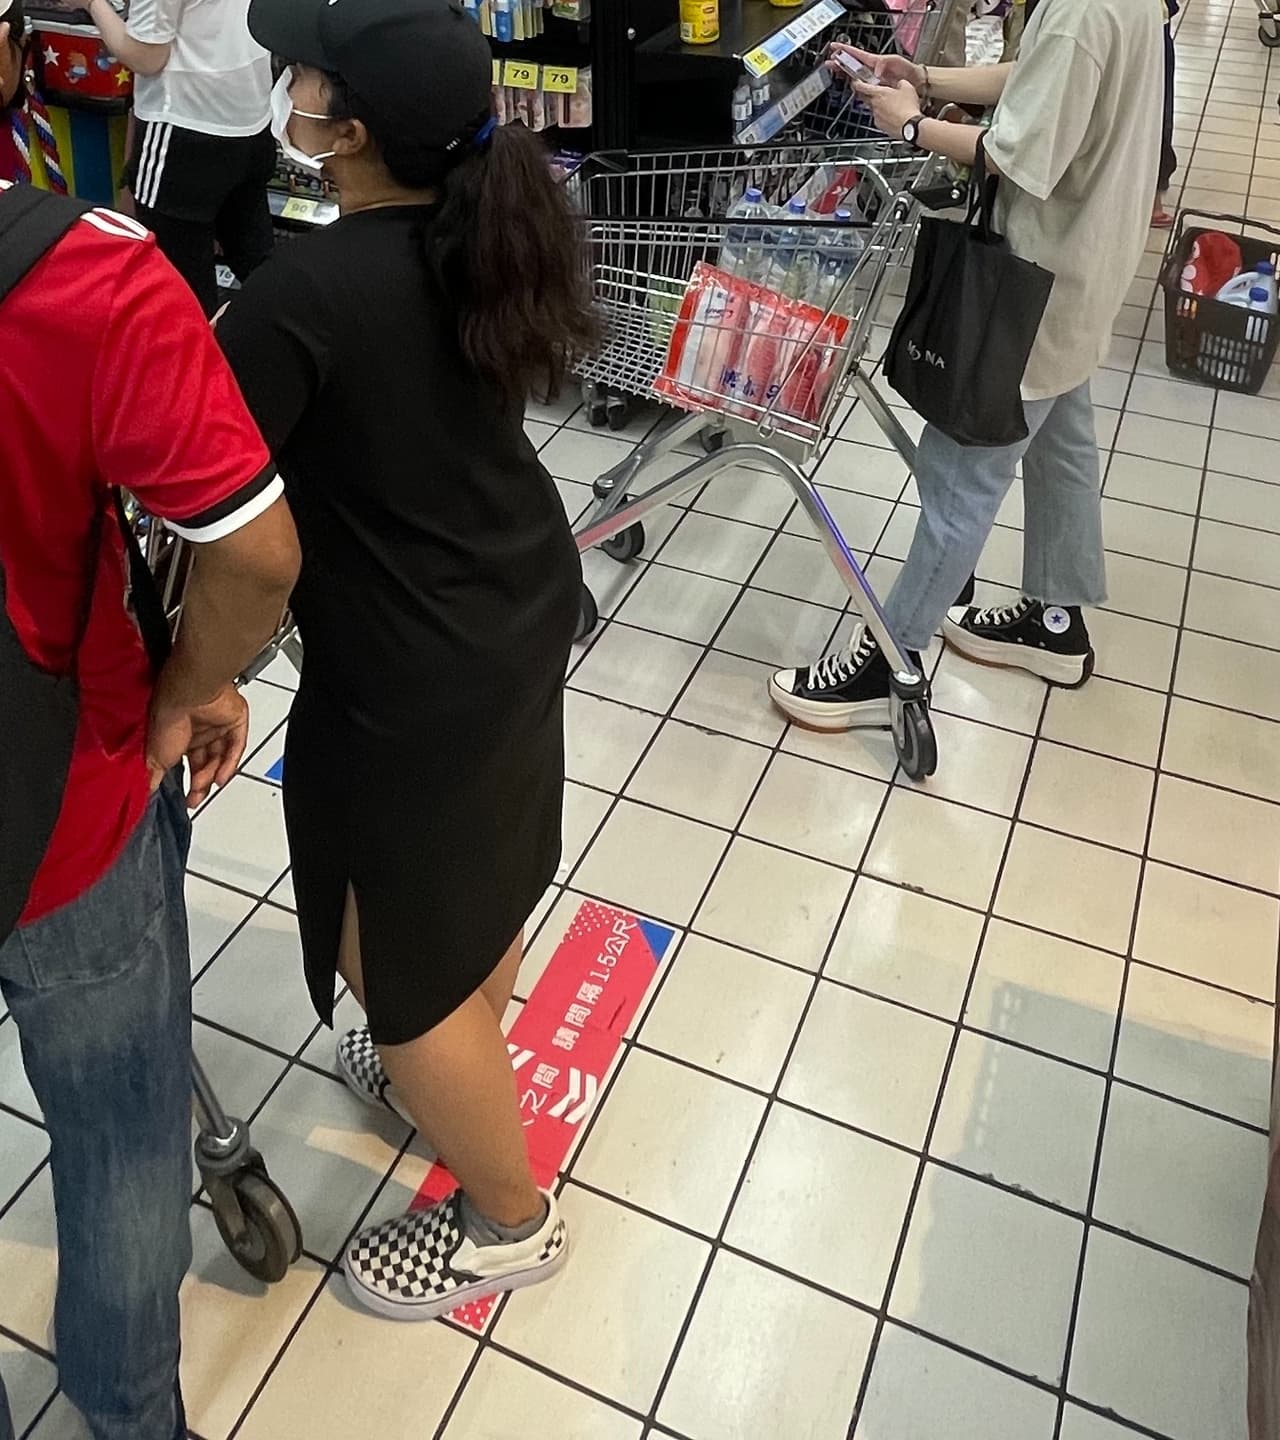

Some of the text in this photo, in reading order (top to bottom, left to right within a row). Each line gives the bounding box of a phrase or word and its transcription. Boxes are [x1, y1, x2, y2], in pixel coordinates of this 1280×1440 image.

[512, 69, 530, 80] 79
[551, 73, 569, 84] 79
[521, 918, 637, 1127] 之間 請間隔1.5公尺
